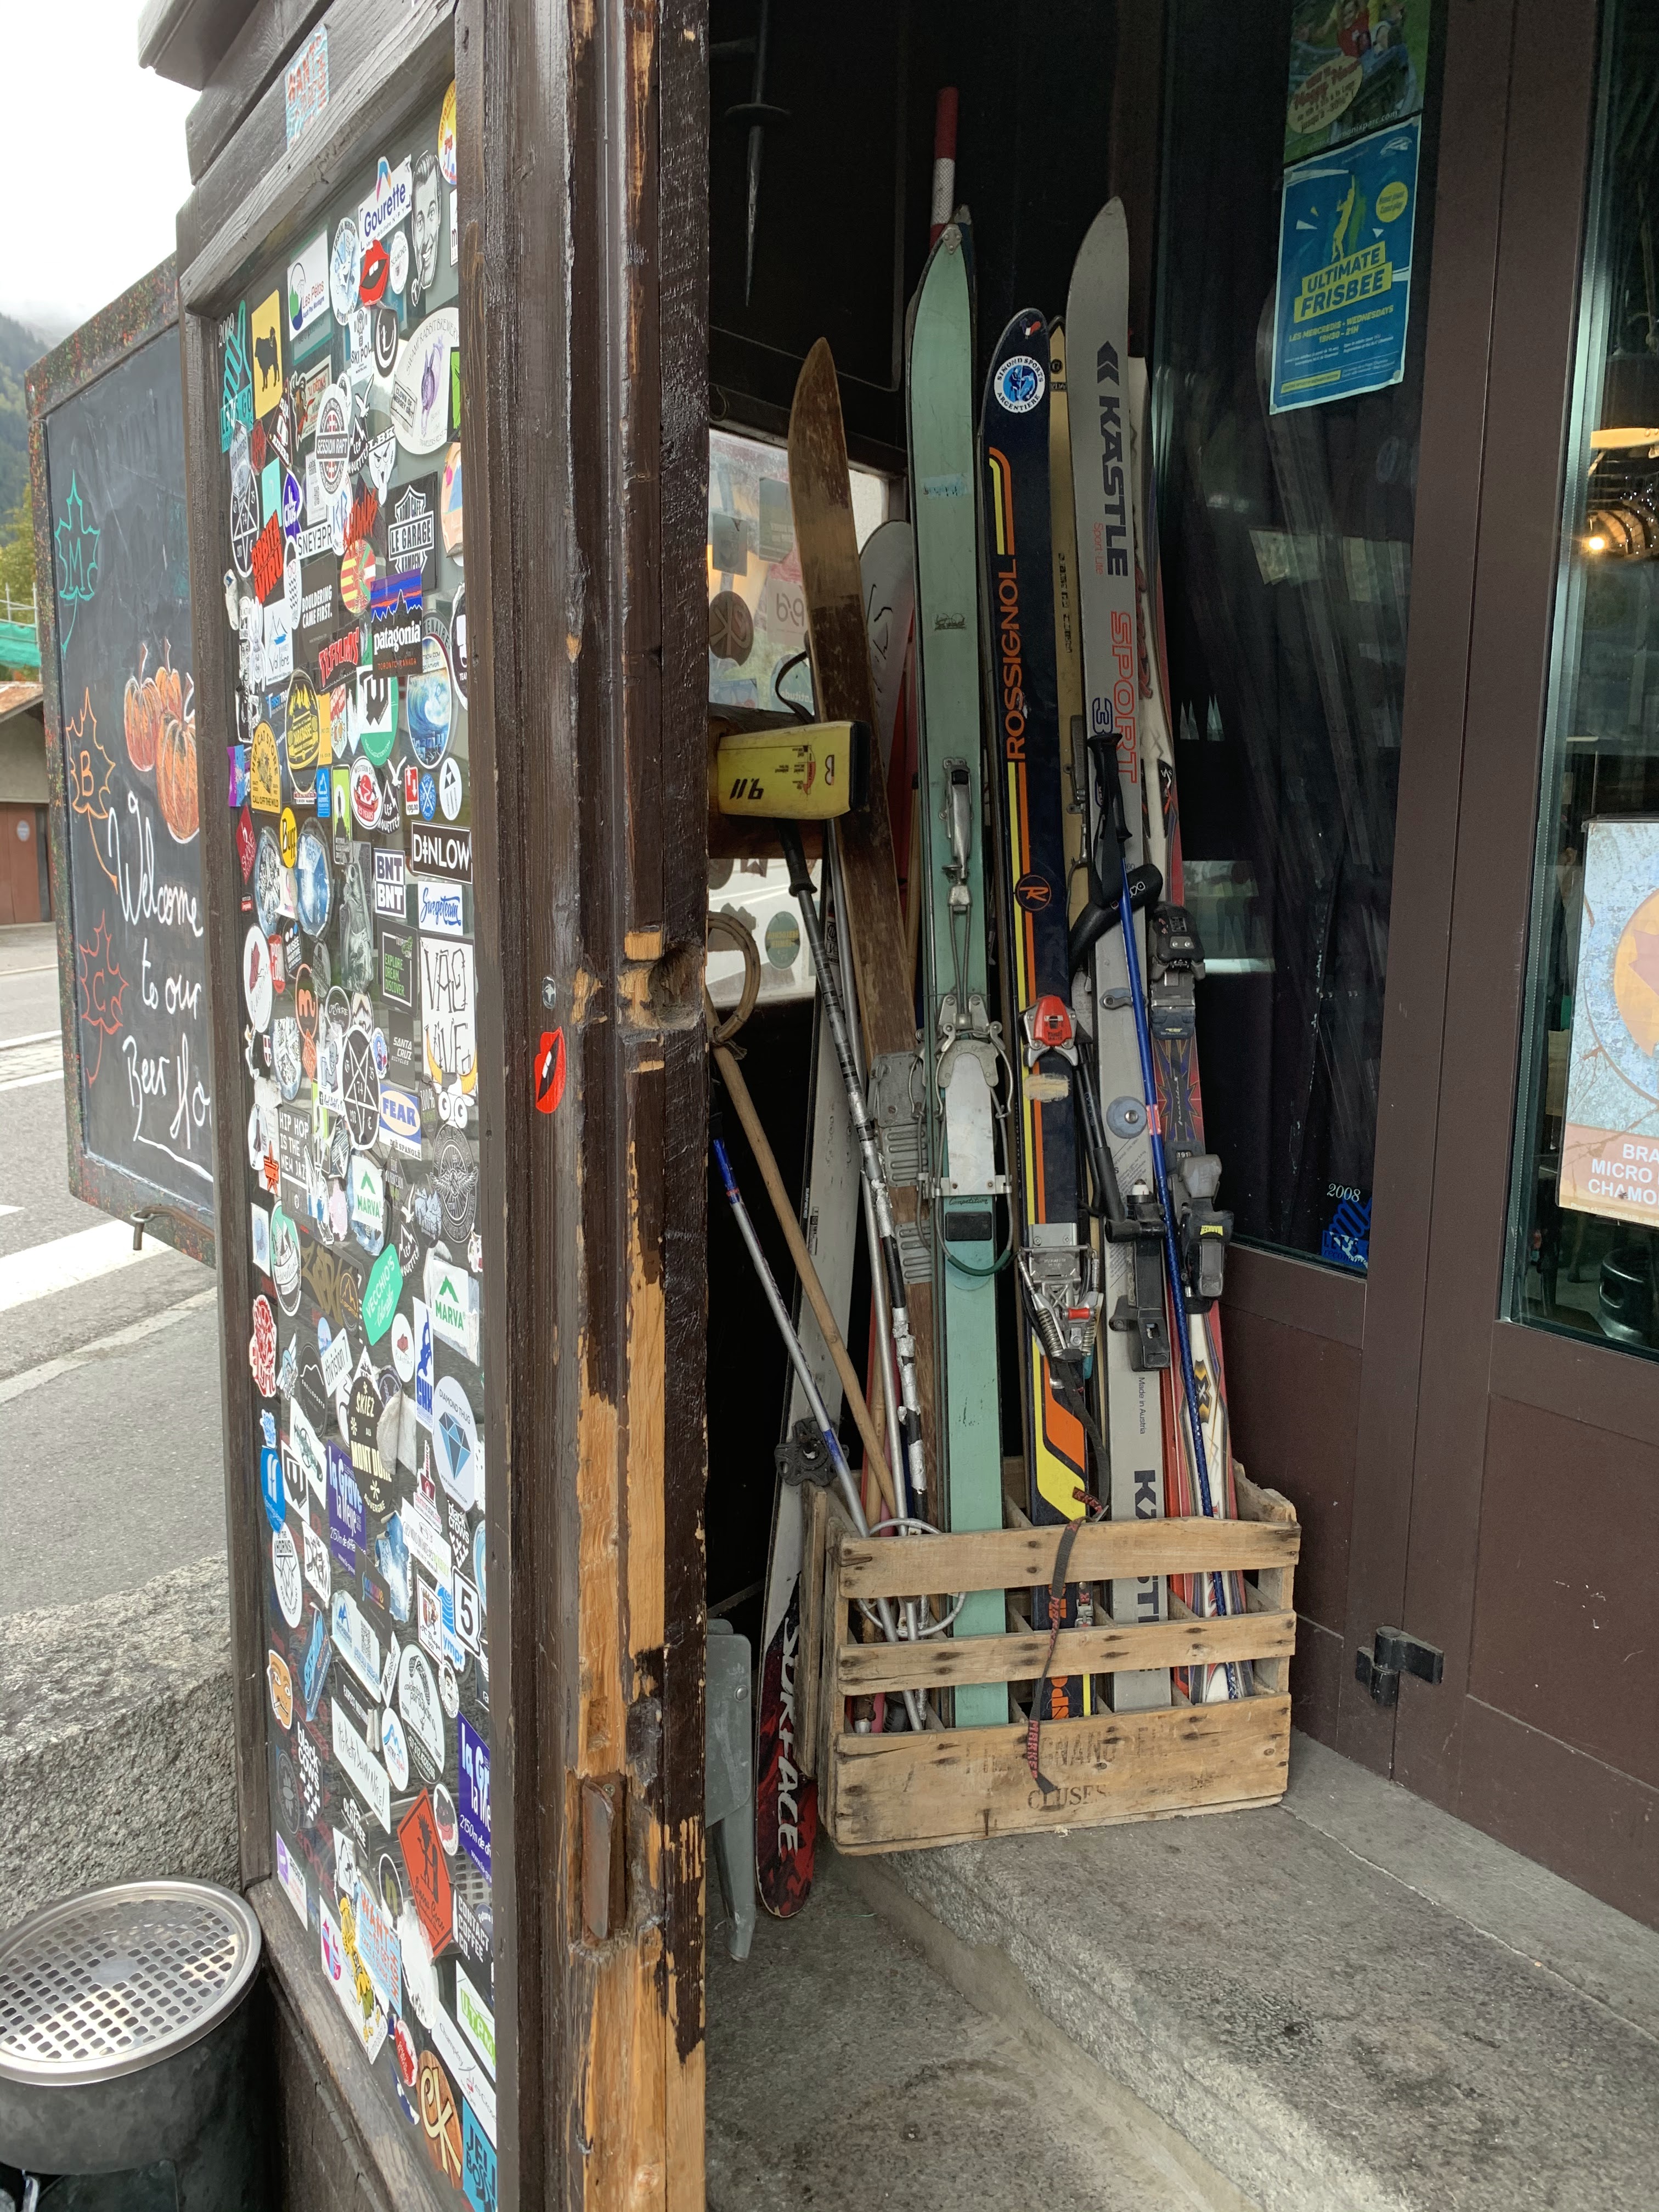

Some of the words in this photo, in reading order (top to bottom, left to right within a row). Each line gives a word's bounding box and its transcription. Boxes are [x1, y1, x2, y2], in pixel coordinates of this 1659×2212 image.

[444, 134, 453, 155] 74
[364, 183, 406, 238] Gourette
[1307, 247, 1380, 293] ULTIMATE
[1301, 268, 1385, 317] FRISBEE
[218, 313, 234, 348] 2009
[437, 318, 459, 342] BREWERY
[1289, 331, 1302, 342] LES
[1303, 321, 1341, 339] MERCREDIS
[1347, 305, 1394, 326] WEDNESDAYS
[351, 349, 360, 364] SKI
[997, 358, 1023, 381] SIMOND
[1024, 358, 1044, 382] SPORTS
[997, 392, 1040, 411] ARGENTIERE
[317, 439, 336, 454] SESSION
[336, 438, 348, 454] RAFT
[353, 438, 362, 455] LES
[1099, 395, 1128, 577] KASTLE
[391, 531, 399, 554] LE
[402, 520, 431, 548] GARAGE
[1093, 522, 1104, 556] Sport
[302, 585, 332, 613] BOULDERING
[303, 607, 316, 629] CAME
[317, 602, 332, 623] FIRST.
[374, 620, 421, 655] patagonia
[377, 662, 397, 670] TORONTO
[400, 657, 417, 667] CANADA
[998, 558, 1026, 760] ROSSIGNOL
[1110, 610, 1138, 784] SPORT
[266, 733, 278, 775] STORE
[354, 764, 368, 774] WESTERN
[80, 751, 94, 797] B
[363, 809, 374, 820] YEARS
[384, 803, 392, 816] LES
[109, 790, 205, 937] Welcome
[377, 855, 402, 882] BNT
[377, 883, 403, 911] BNT
[93, 968, 106, 1012] C
[142, 938, 158, 1009] to
[165, 973, 202, 1019] our
[393, 1037, 412, 1050] SANTA
[397, 1048, 412, 1060] CRUZ
[391, 1056, 409, 1065] BICYCLES
[122, 1035, 170, 1141] Beer
[357, 1081, 363, 1095] 74
[420, 1088, 435, 1111] 100%
[279, 1111, 291, 1132] HIP
[294, 1118, 309, 1140] HOP
[383, 1098, 417, 1127] FEAR
[280, 1133, 287, 1150] IS
[289, 1137, 301, 1157] THE
[281, 1154, 294, 1173] NEW
[1592, 1158, 1652, 1183] MICRO
[357, 1195, 380, 1219] MARVA
[1327, 1183, 1361, 1203] 2008
[365, 1255, 395, 1318] VECCHIO'S
[435, 1300, 464, 1331] MARVA
[325, 1349, 345, 1386] division
[356, 1392, 375, 1418] SKIEZ
[439, 1389, 459, 1412] DIAMOND
[458, 1406, 471, 1425] THUG
[351, 1440, 372, 1474] MONT
[329, 1446, 337, 1491] la
[338, 1458, 363, 1514] Grave
[364, 1493, 386, 1513] AUVERGNE
[448, 1500, 466, 1530] black
[448, 1515, 470, 1544] crows
[461, 1586, 473, 1636] 5
[297, 1722, 319, 1773] black
[462, 1722, 473, 1778] la
[298, 1746, 320, 1791] crows
[471, 1776, 478, 1815] la
[343, 1798, 353, 1824] OLD
[353, 1810, 366, 1847] TREE
[460, 1814, 478, 1843] 2150m
[477, 1835, 485, 1849] de
[361, 1892, 390, 1950] WANT
[458, 1895, 489, 1951] CONTACT
[459, 1914, 483, 1963] COFFEE
[459, 1933, 470, 1960] CO.
